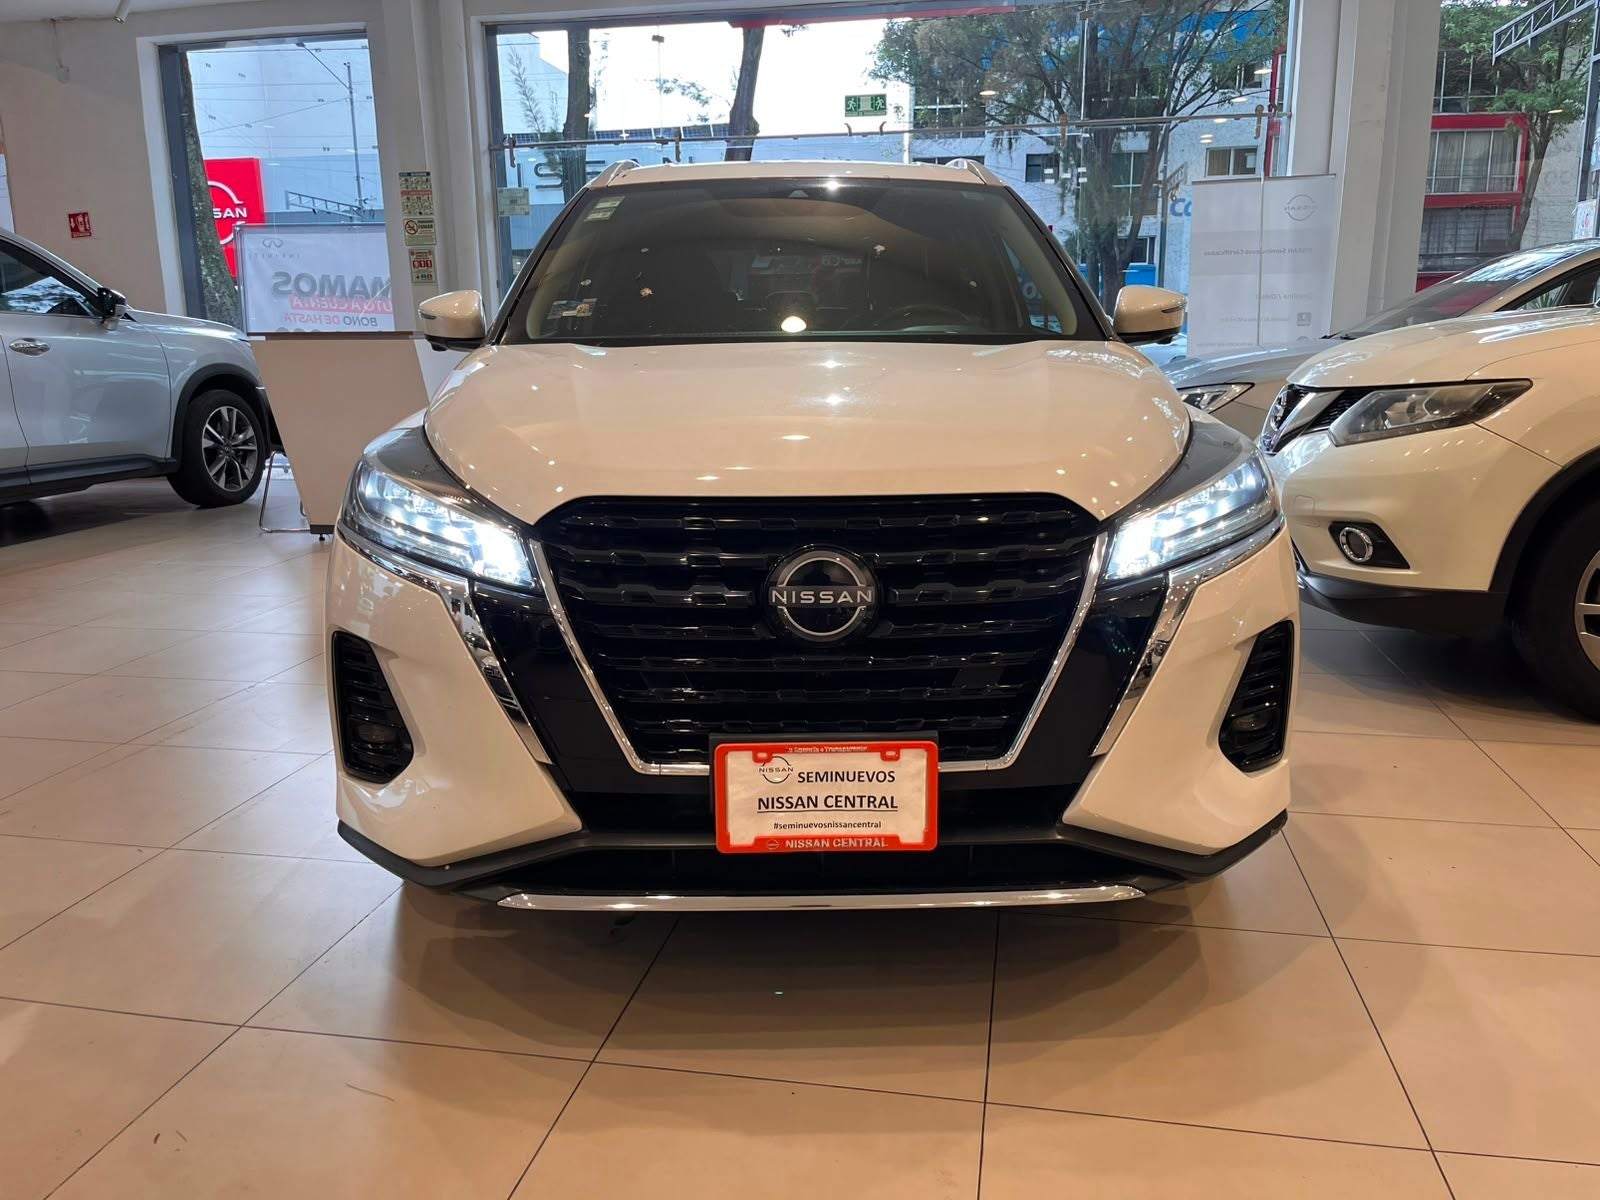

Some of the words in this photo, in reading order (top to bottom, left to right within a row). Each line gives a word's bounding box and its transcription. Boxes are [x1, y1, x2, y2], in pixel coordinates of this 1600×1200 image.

[213, 208, 247, 218] SAN
[770, 589, 873, 604] NISSAN
[797, 770, 896, 783] SEMINUEVOS
[757, 796, 818, 810] NISSAN
[823, 795, 899, 809] CENTRAL
[773, 820, 882, 830] #seminuevosnissancentral
[785, 840, 830, 850] NISSAN
[833, 838, 888, 848] CENTRAL
